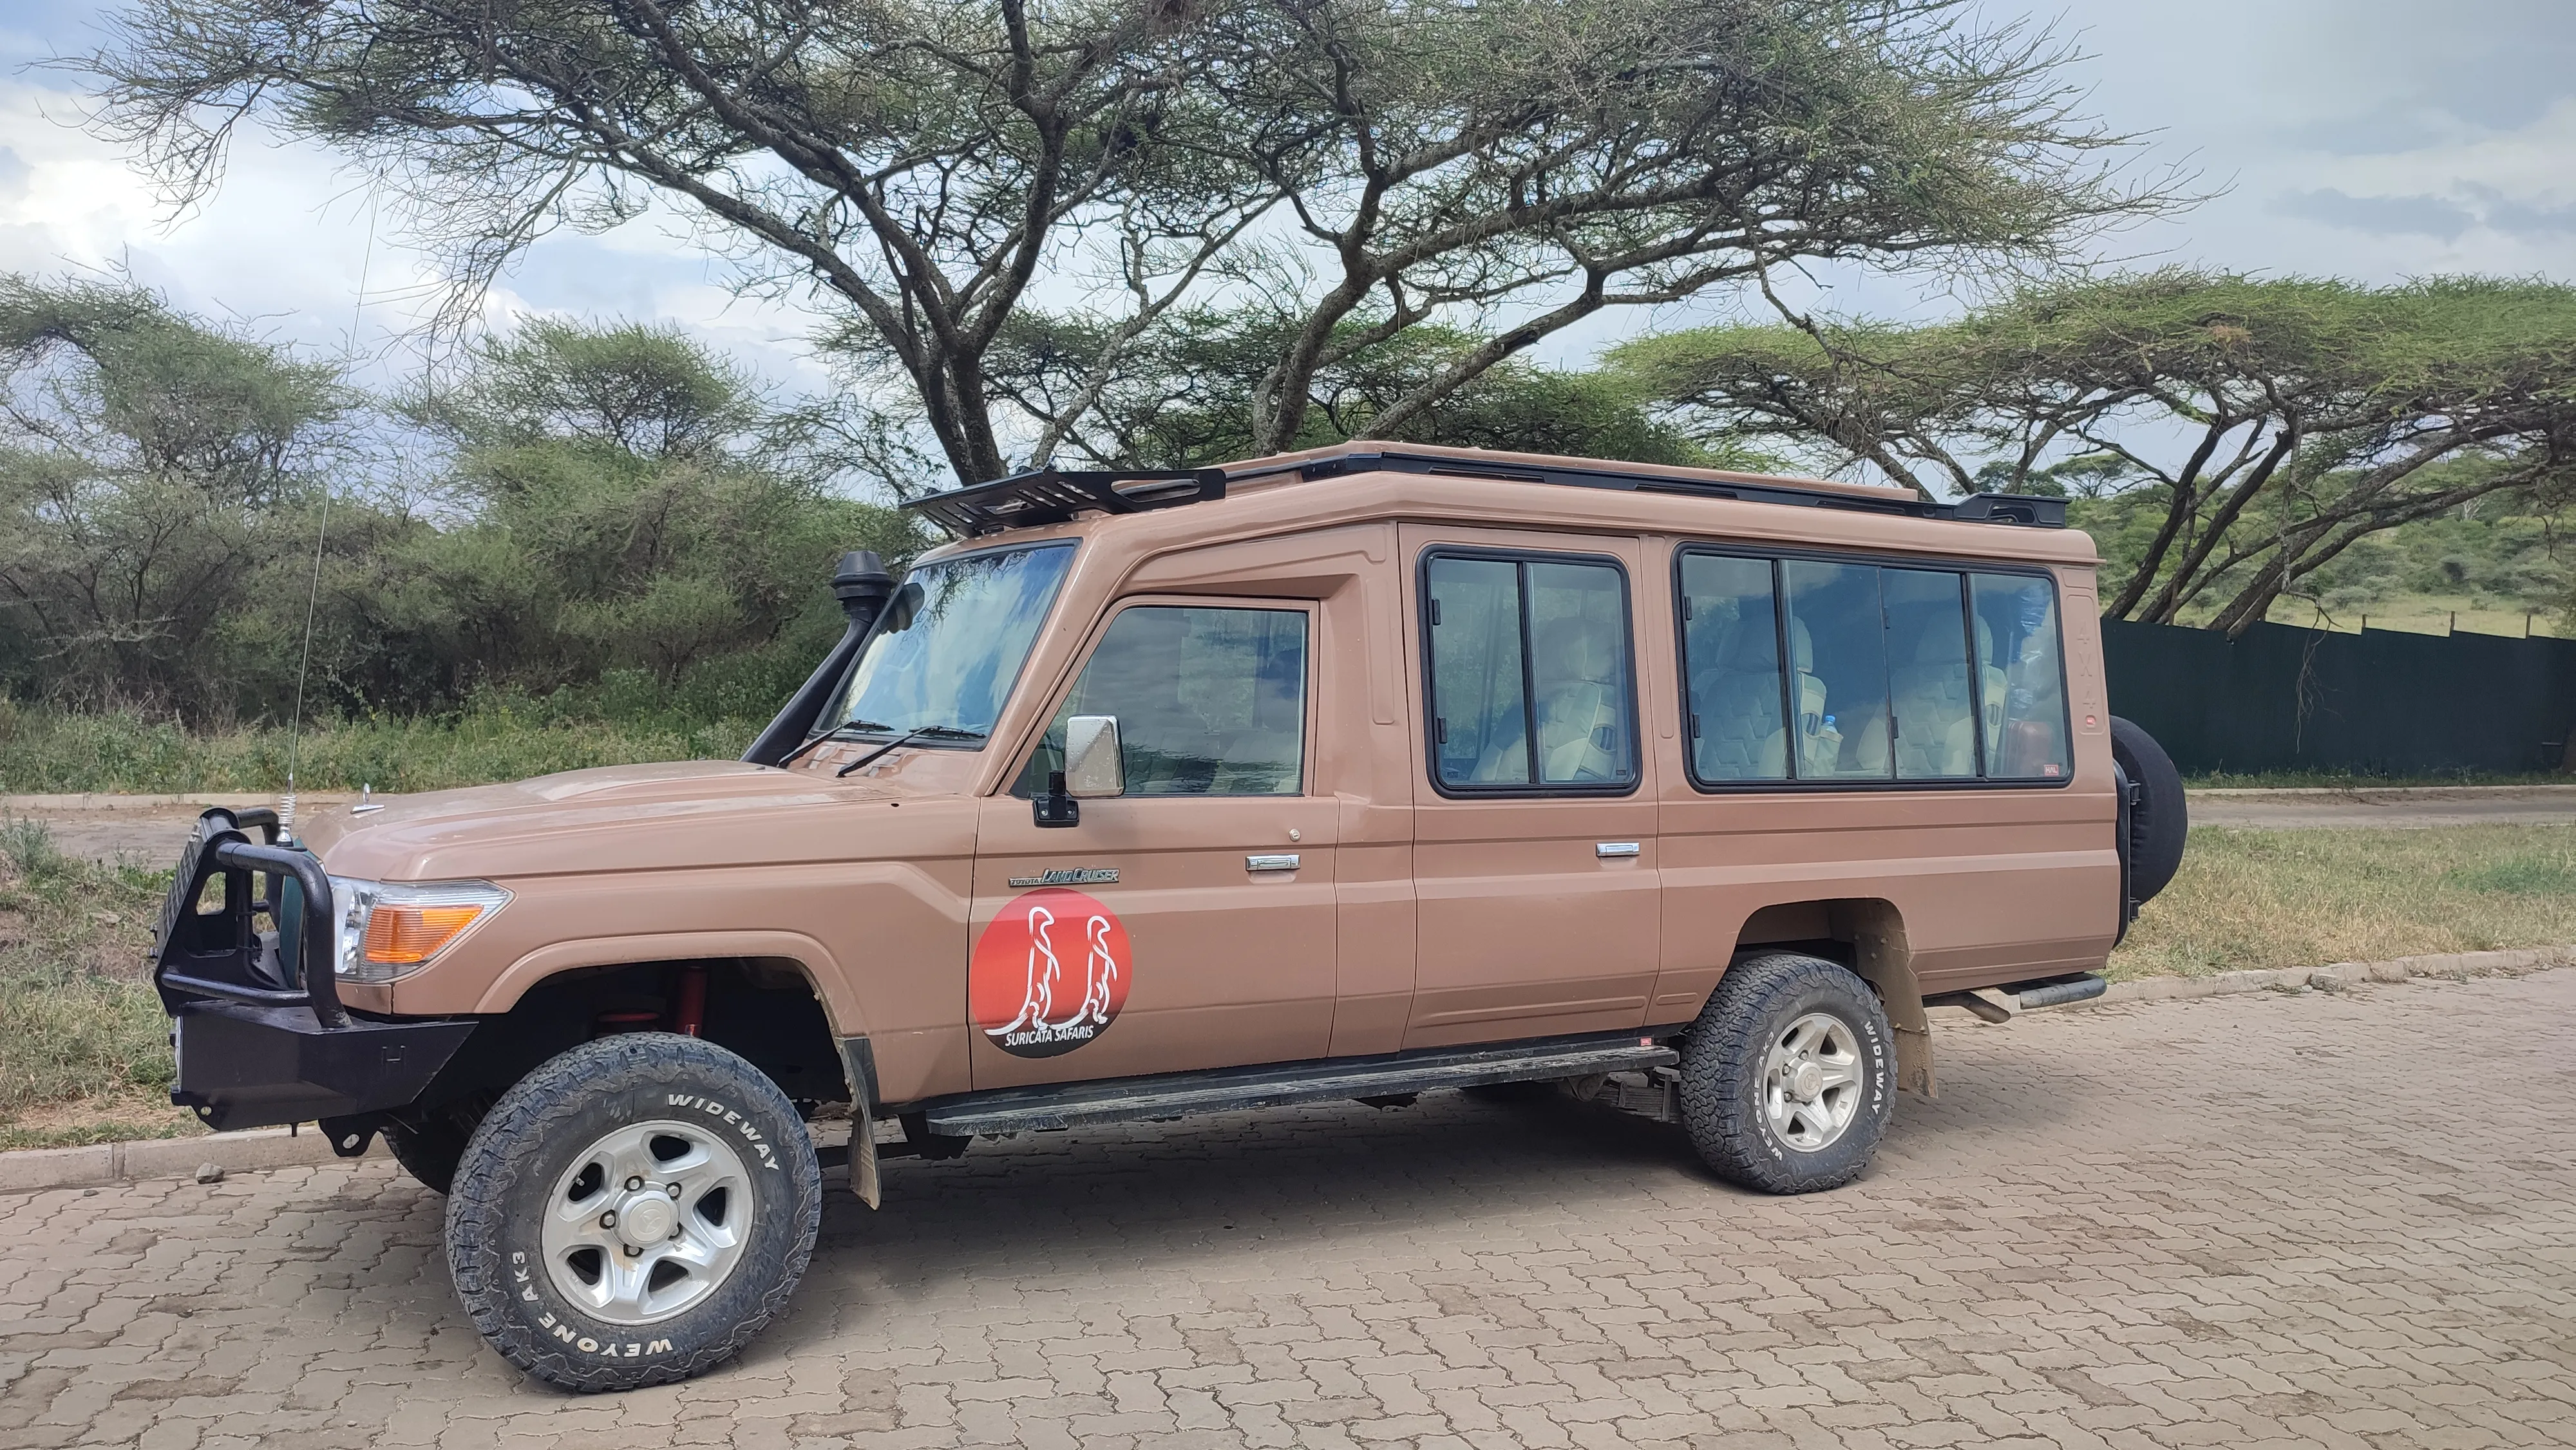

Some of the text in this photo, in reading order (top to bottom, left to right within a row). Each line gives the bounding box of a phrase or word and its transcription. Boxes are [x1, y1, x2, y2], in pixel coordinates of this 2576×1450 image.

[1005, 1025, 1094, 1047] SURICATA SAFARIS
[1864, 1021, 1884, 1115] WIDEWAY
[668, 1094, 780, 1171] WIDEWAY
[1754, 1031, 1783, 1161] WEYONE AK3
[513, 1251, 673, 1357] WEYONE AK3
